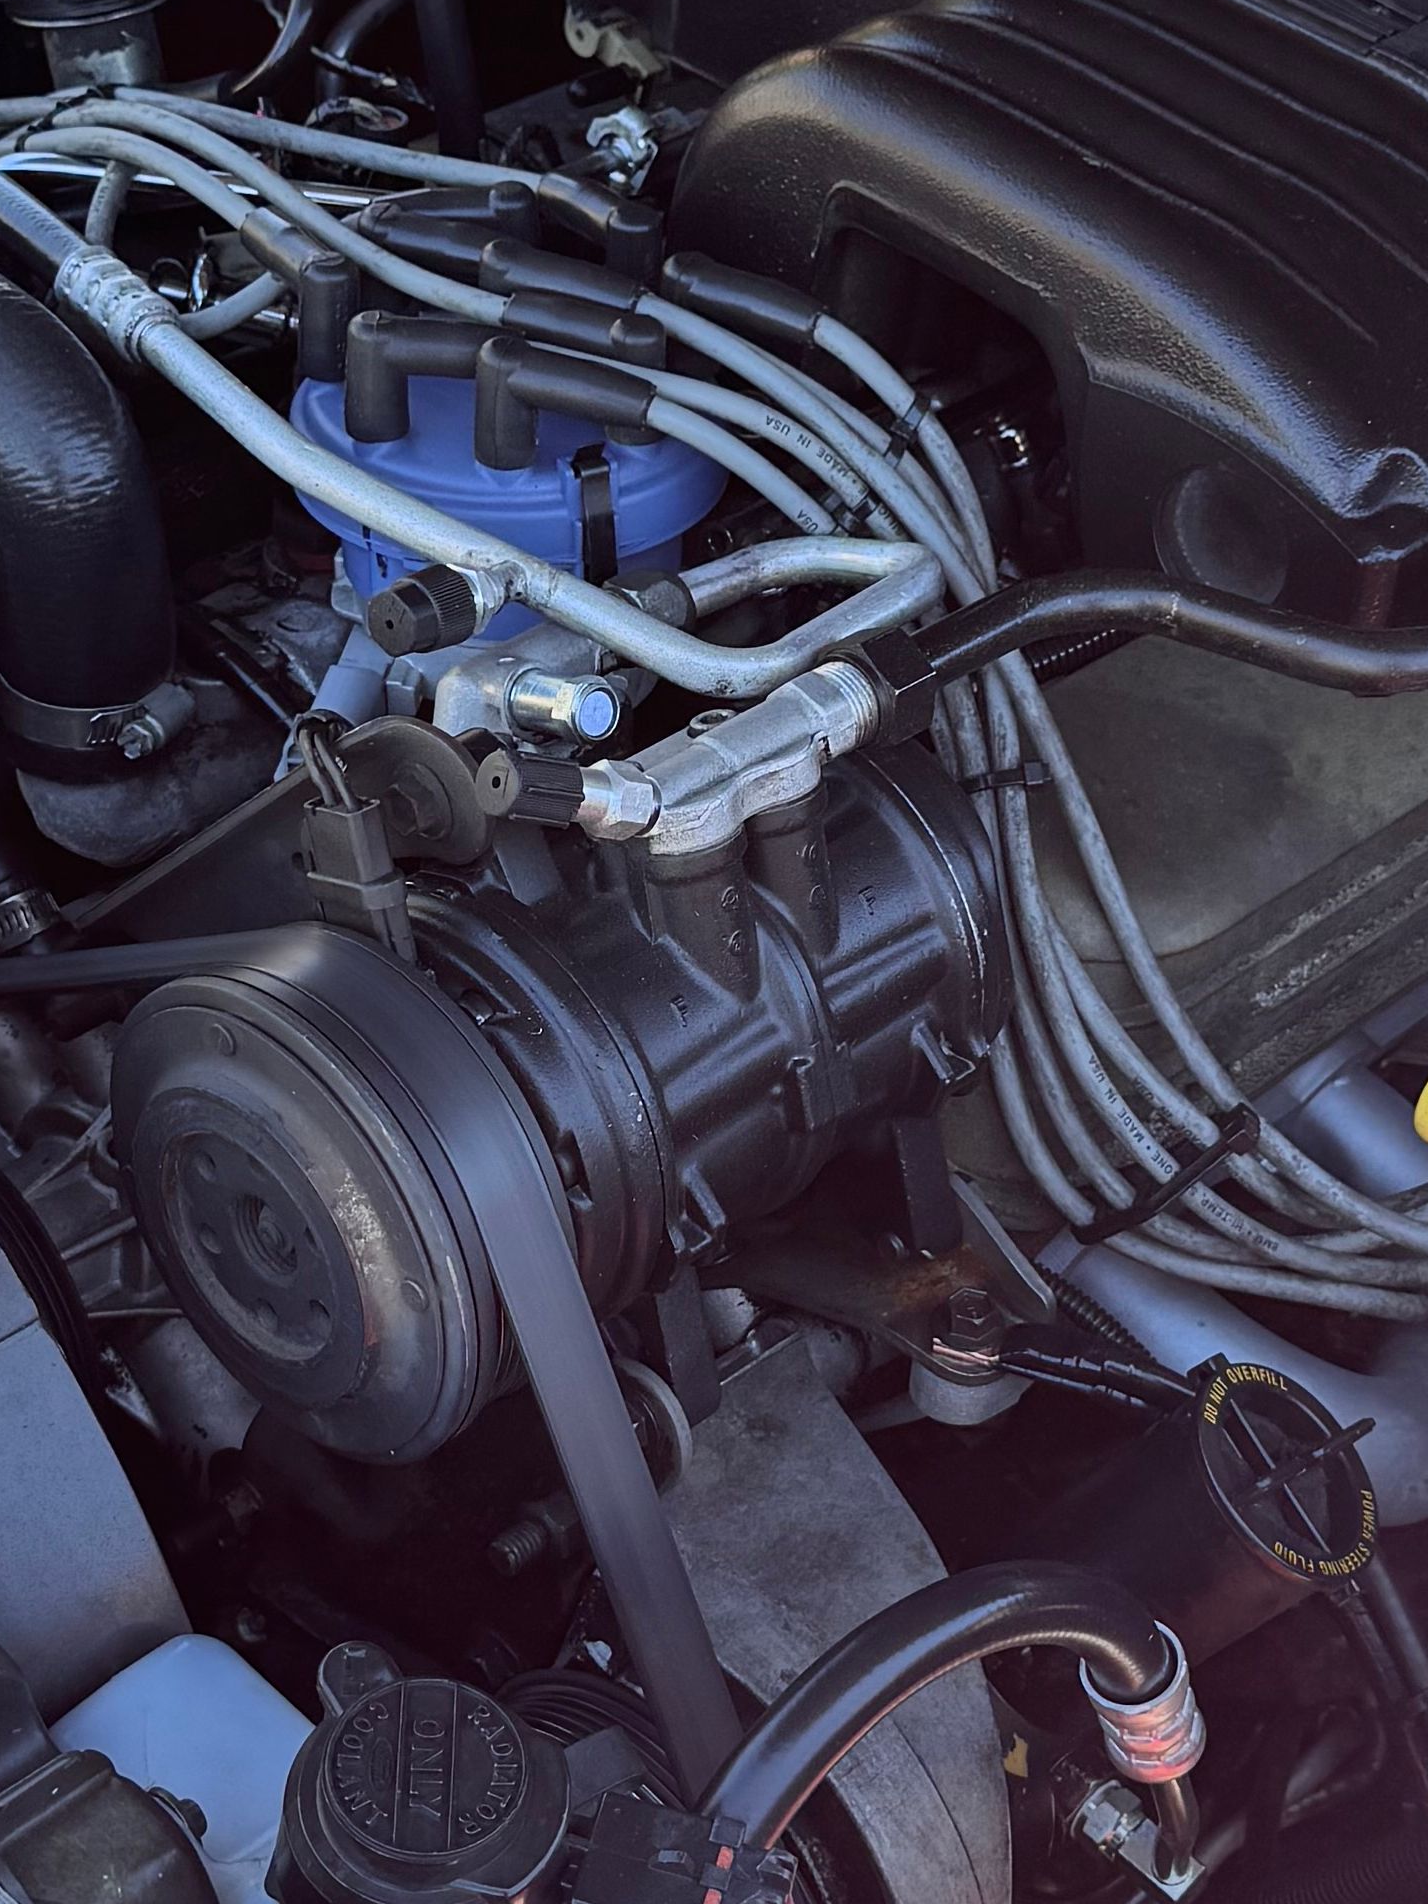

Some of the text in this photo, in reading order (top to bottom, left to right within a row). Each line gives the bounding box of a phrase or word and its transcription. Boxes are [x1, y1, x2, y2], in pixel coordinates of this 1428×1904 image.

[765, 414, 791, 433] USA
[796, 433, 811, 449] IN
[796, 508, 819, 533] USA
[1089, 1054, 1105, 1085] USA
[1104, 1088, 1117, 1106] IN
[1116, 1110, 1144, 1146] MADE
[1202, 1365, 1290, 1425] DO NOT OVERFILL
[1274, 1488, 1374, 1576] POWER STEERING FLUID
[335, 1700, 390, 1828] COOLANT
[408, 1718, 446, 1819] ONLY
[457, 1703, 520, 1836] RADIATOR
